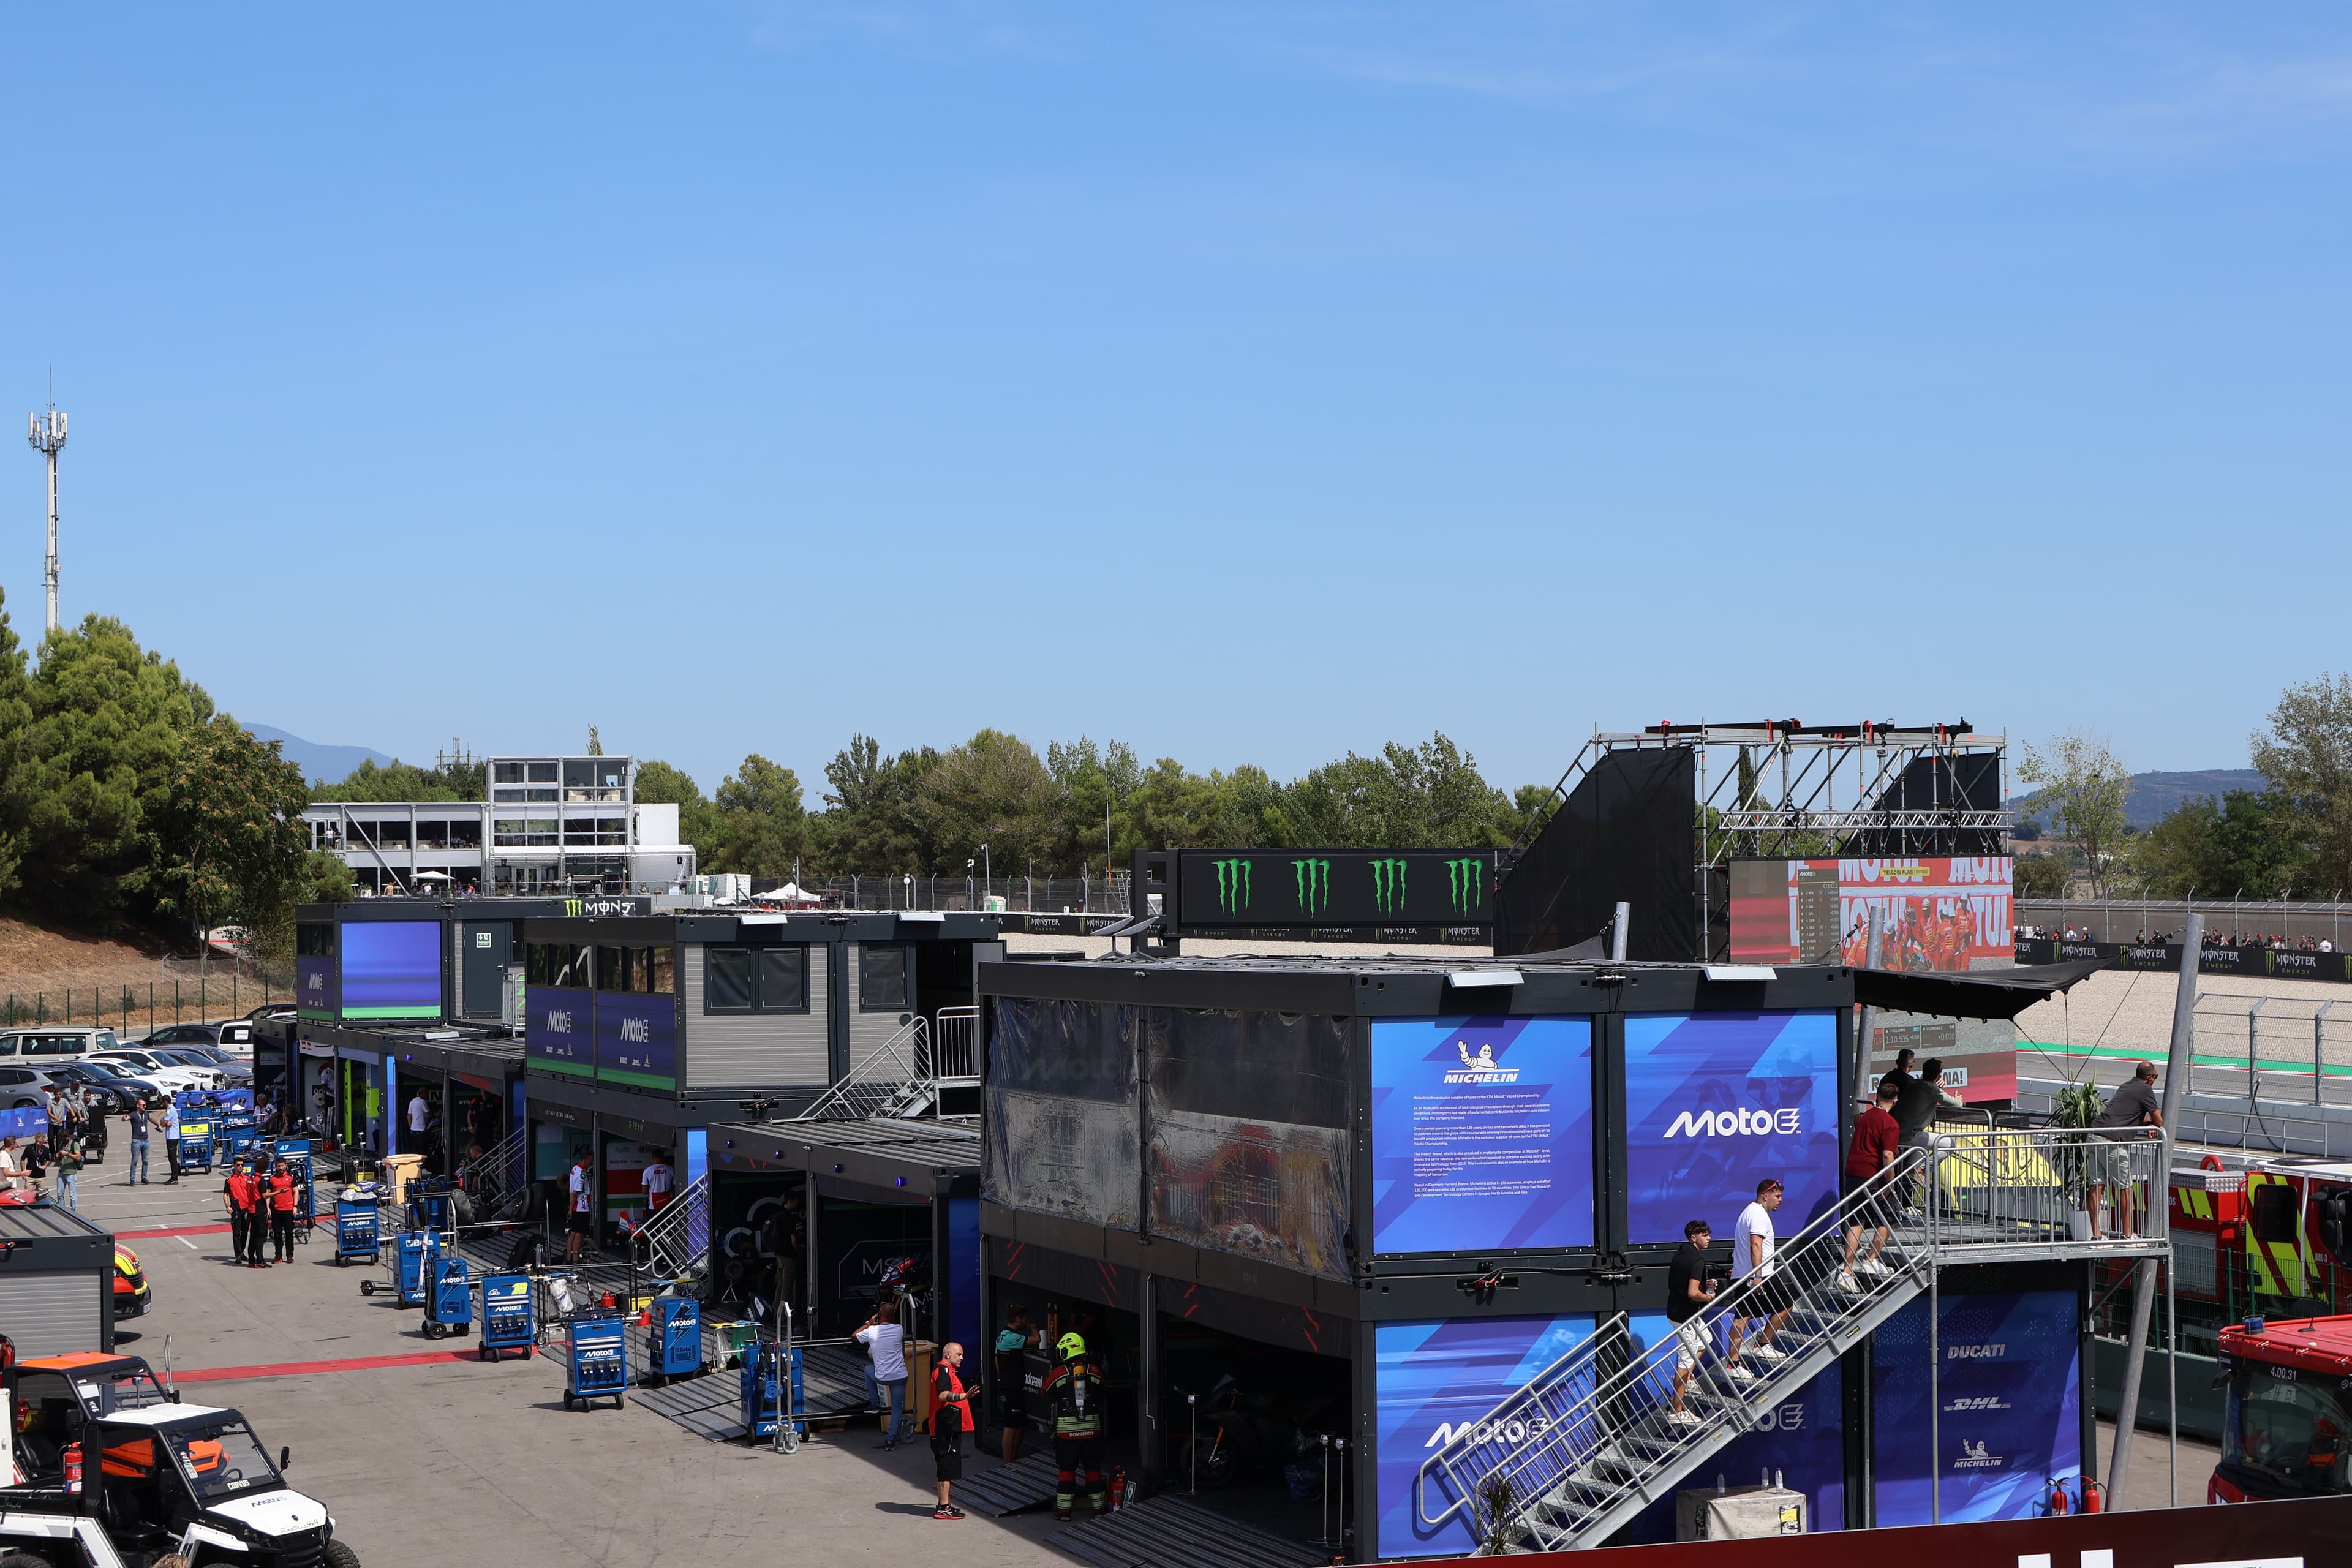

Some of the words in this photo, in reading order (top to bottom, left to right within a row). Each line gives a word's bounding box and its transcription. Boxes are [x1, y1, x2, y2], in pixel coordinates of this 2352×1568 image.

[1031, 918, 1060, 926] MONSTER
[2062, 944, 2097, 958] MONSTER
[2201, 948, 2239, 962] MONSTER
[2275, 952, 2316, 968] MONSTER
[620, 1017, 649, 1043] MotoE
[1886, 1035, 1910, 1044] 1:10.535
[1444, 1073, 1518, 1084] MICHELIN
[668, 1319, 697, 1328] MotoE
[584, 1349, 614, 1358] MotoE
[1947, 1343, 2006, 1359] DUCATI
[2270, 1366, 2297, 1381] 4.00.31
[1951, 1396, 2003, 1411] DHL
[1953, 1459, 2002, 1468] MICHELIN
[227, 1479, 251, 1490] CORVUS
